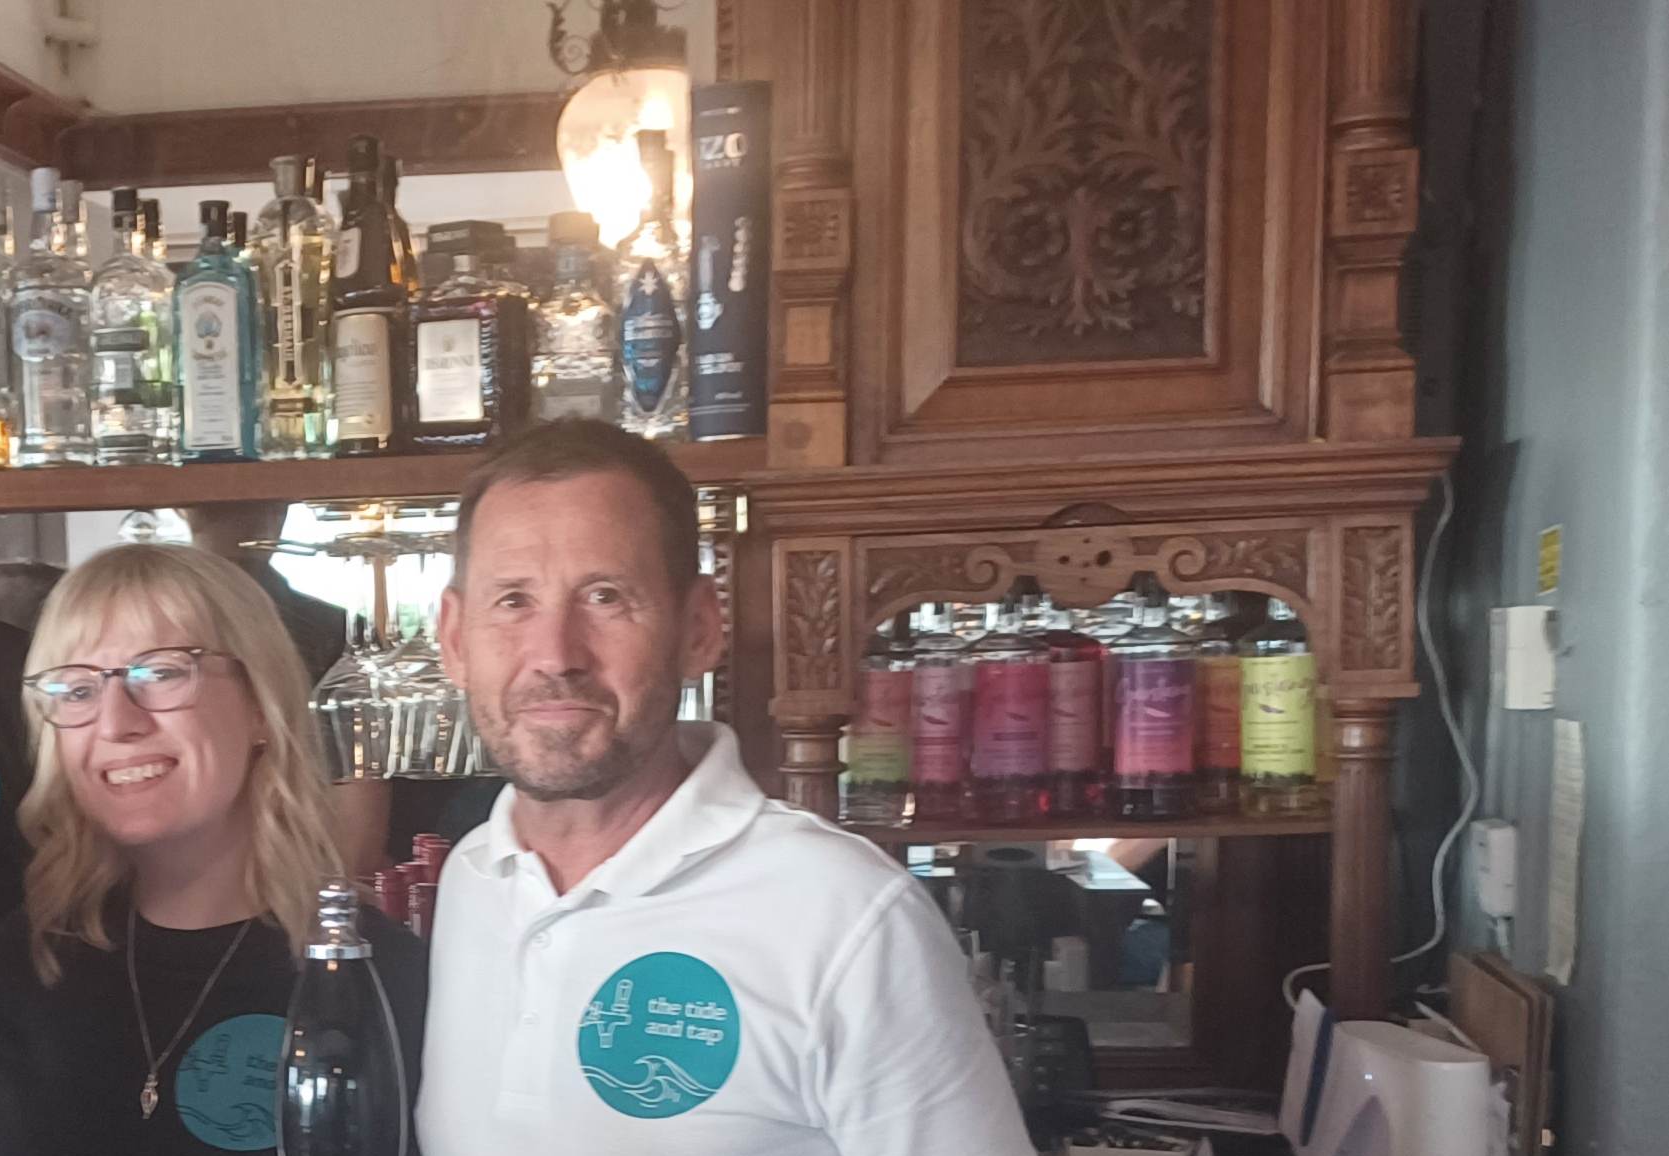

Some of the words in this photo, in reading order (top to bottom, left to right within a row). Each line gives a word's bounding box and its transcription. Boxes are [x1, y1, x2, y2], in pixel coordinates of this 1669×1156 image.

[647, 996, 682, 1016] the
[684, 1001, 728, 1021] tide
[644, 1019, 684, 1038] and
[685, 1024, 724, 1047] tap
